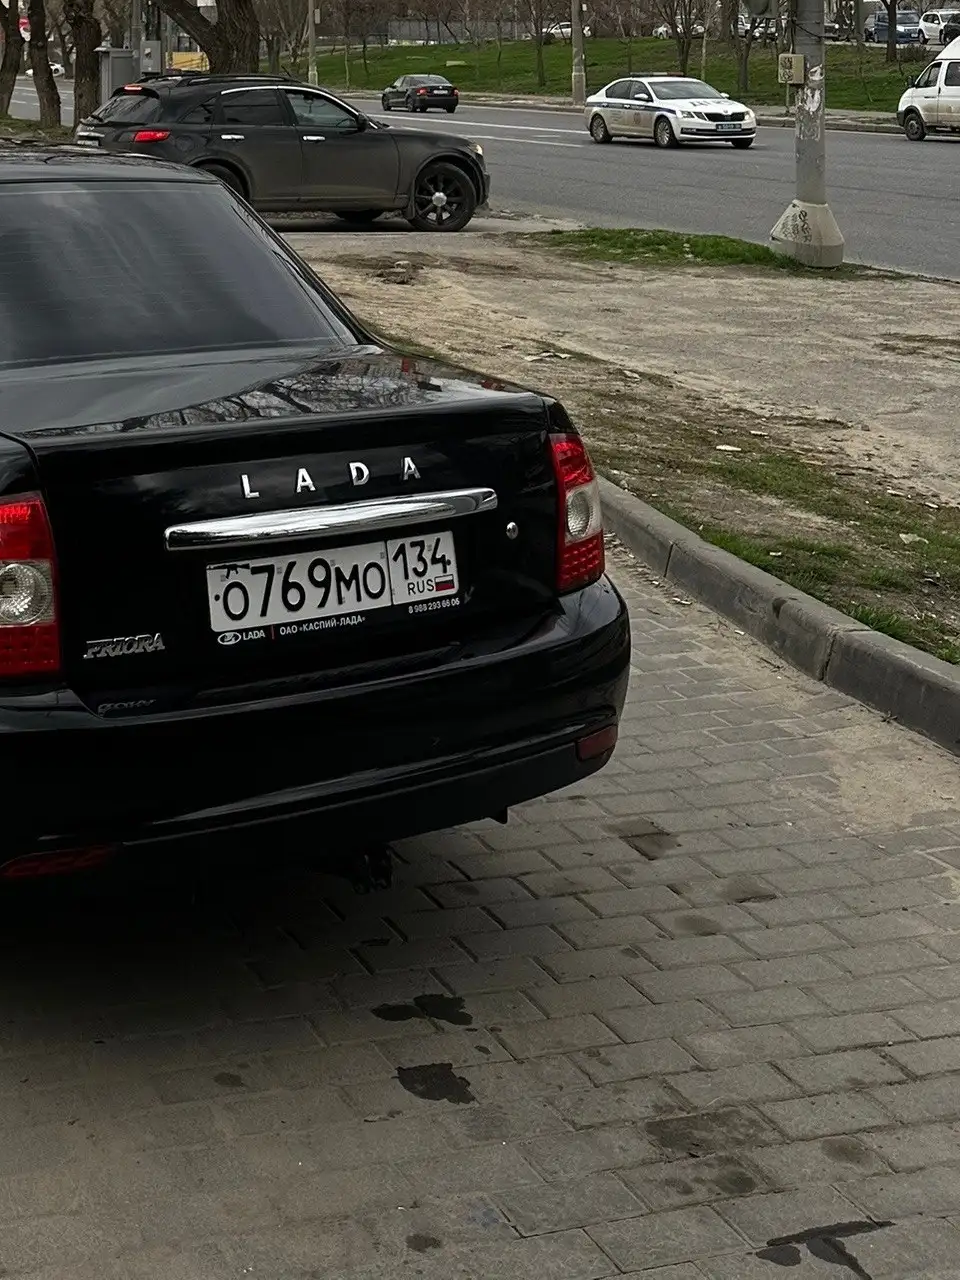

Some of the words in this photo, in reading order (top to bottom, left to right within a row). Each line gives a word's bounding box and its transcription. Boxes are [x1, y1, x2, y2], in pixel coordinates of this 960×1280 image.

[241, 456, 422, 499] LADA
[222, 557, 386, 621] О769МО
[392, 537, 448, 581] 134
[407, 579, 435, 596] RUS
[408, 605, 414, 614] 8
[242, 629, 266, 641] LADA
[279, 624, 298, 636] ОАО
[83, 632, 166, 659] PRIORA
